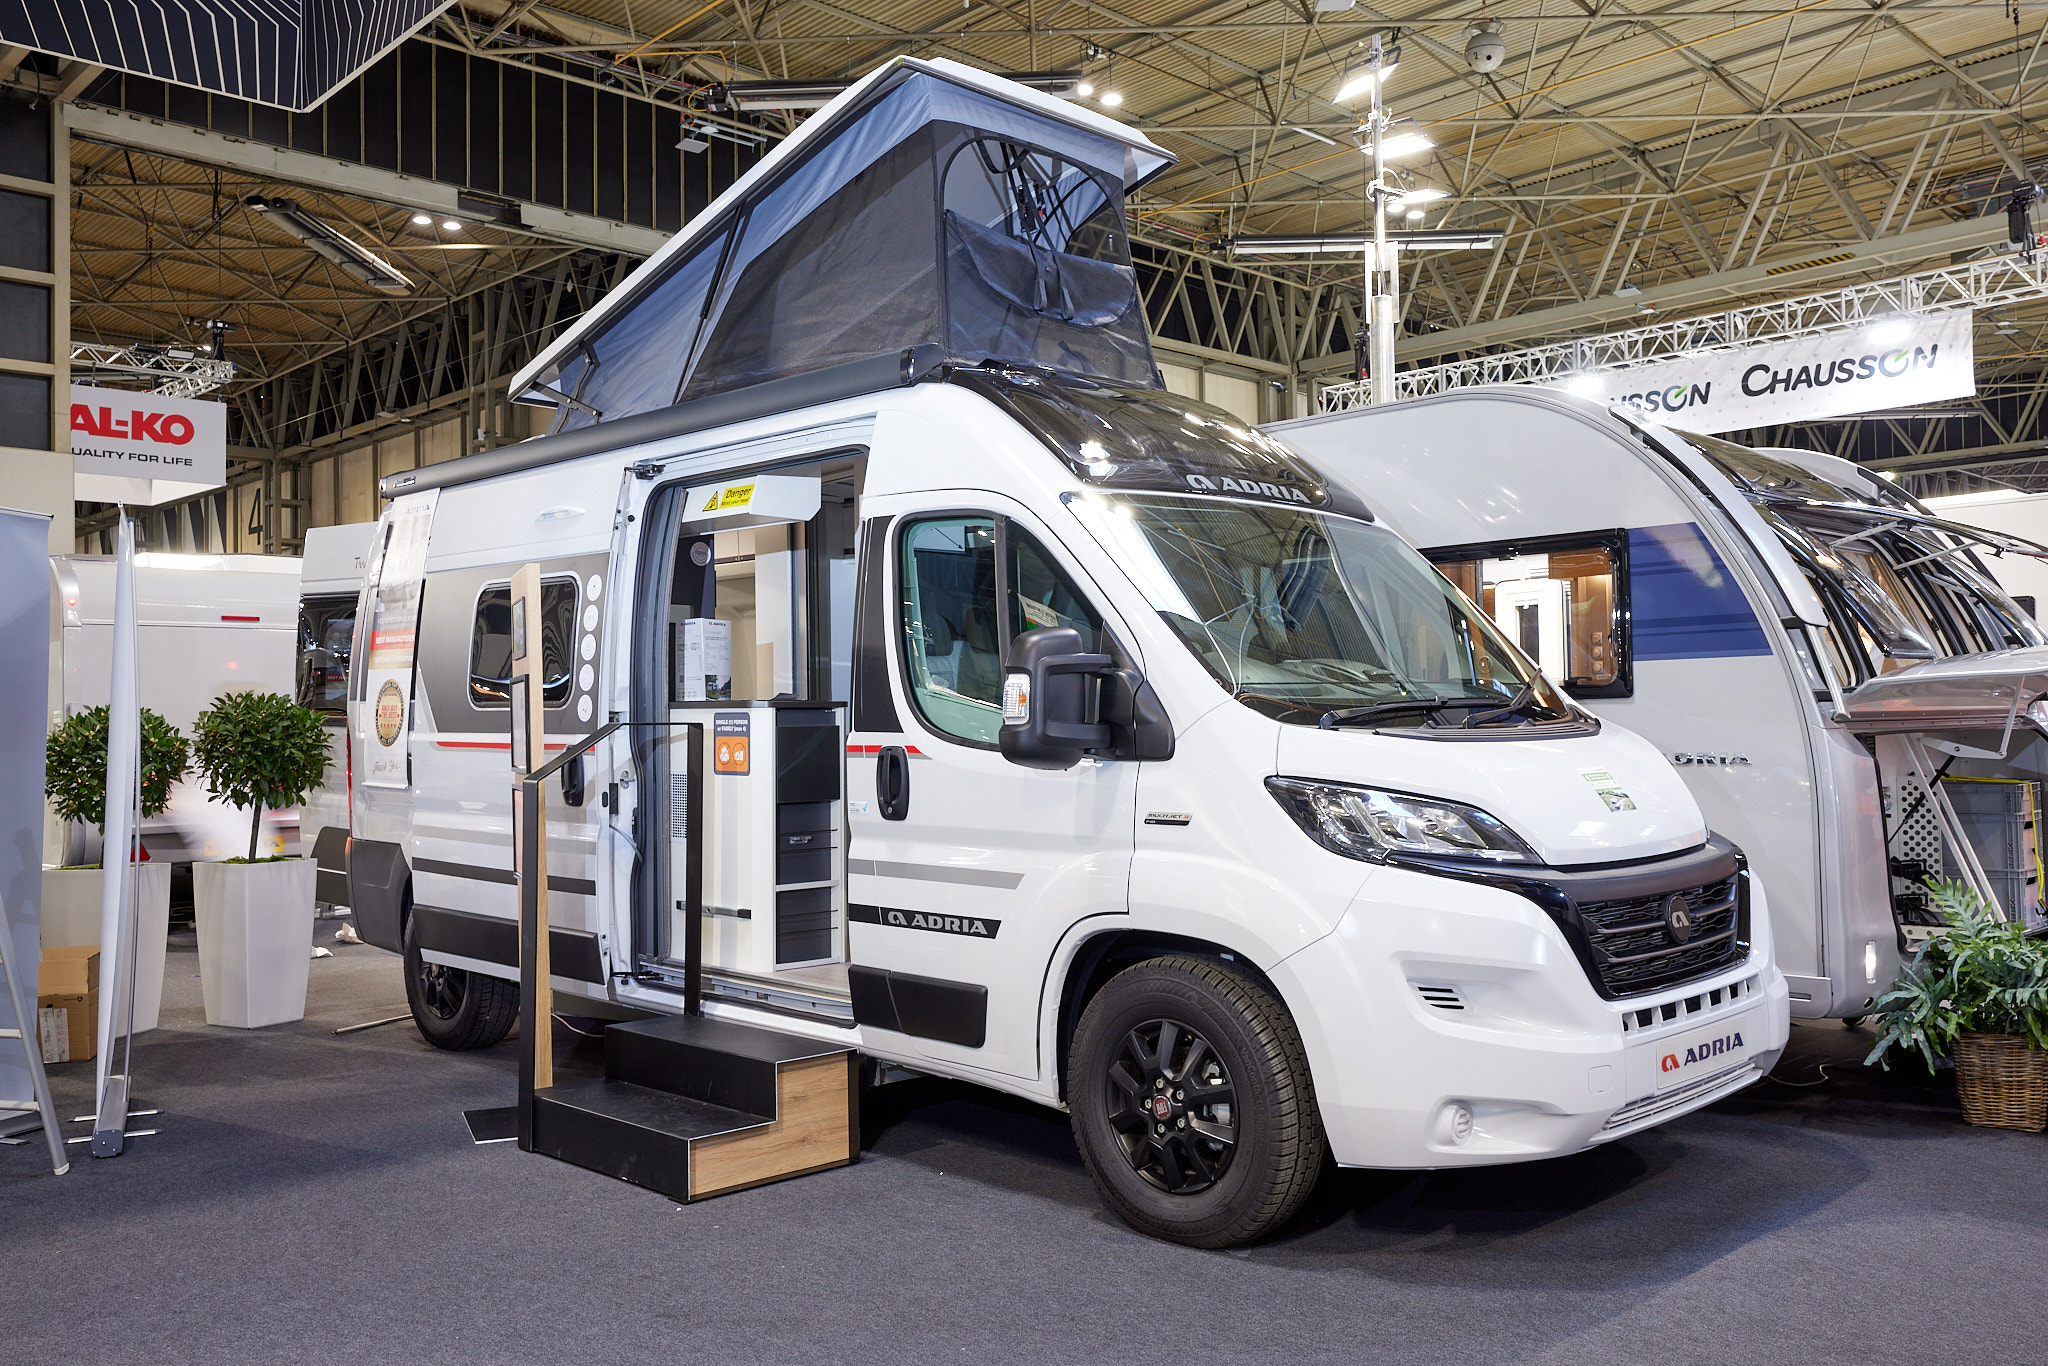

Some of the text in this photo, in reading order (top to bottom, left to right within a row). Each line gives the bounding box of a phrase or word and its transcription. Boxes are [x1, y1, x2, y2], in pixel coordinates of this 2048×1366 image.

[1473, 51, 1480, 60] 2
[1741, 343, 1939, 397] CHAUSSON
[70, 403, 195, 445] AL-KO
[71, 447, 193, 466] UALITY FOR LIFE
[725, 488, 752, 499] Danger
[1221, 476, 1312, 504] ADRIA
[248, 487, 264, 546] 4
[354, 556, 368, 570] Tw
[1662, 752, 1752, 767] DRIA
[911, 913, 988, 935] ADRIA
[1683, 1032, 1744, 1067] ADRIA
